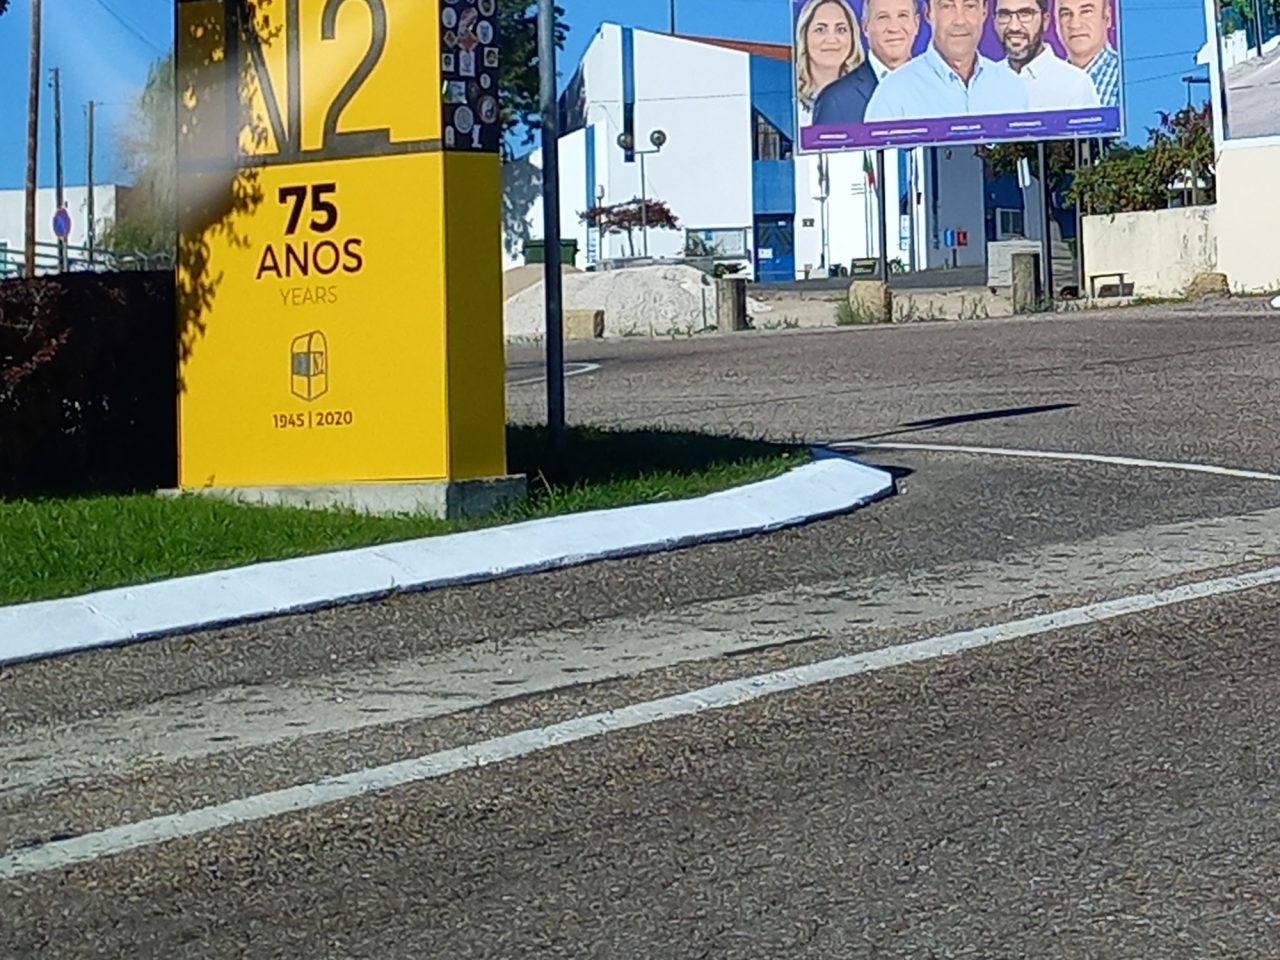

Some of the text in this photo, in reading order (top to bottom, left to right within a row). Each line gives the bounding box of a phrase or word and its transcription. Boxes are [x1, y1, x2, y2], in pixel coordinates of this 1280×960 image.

[278, 182, 338, 236] 75
[255, 237, 363, 280] ANOS
[279, 285, 338, 306] YEARS
